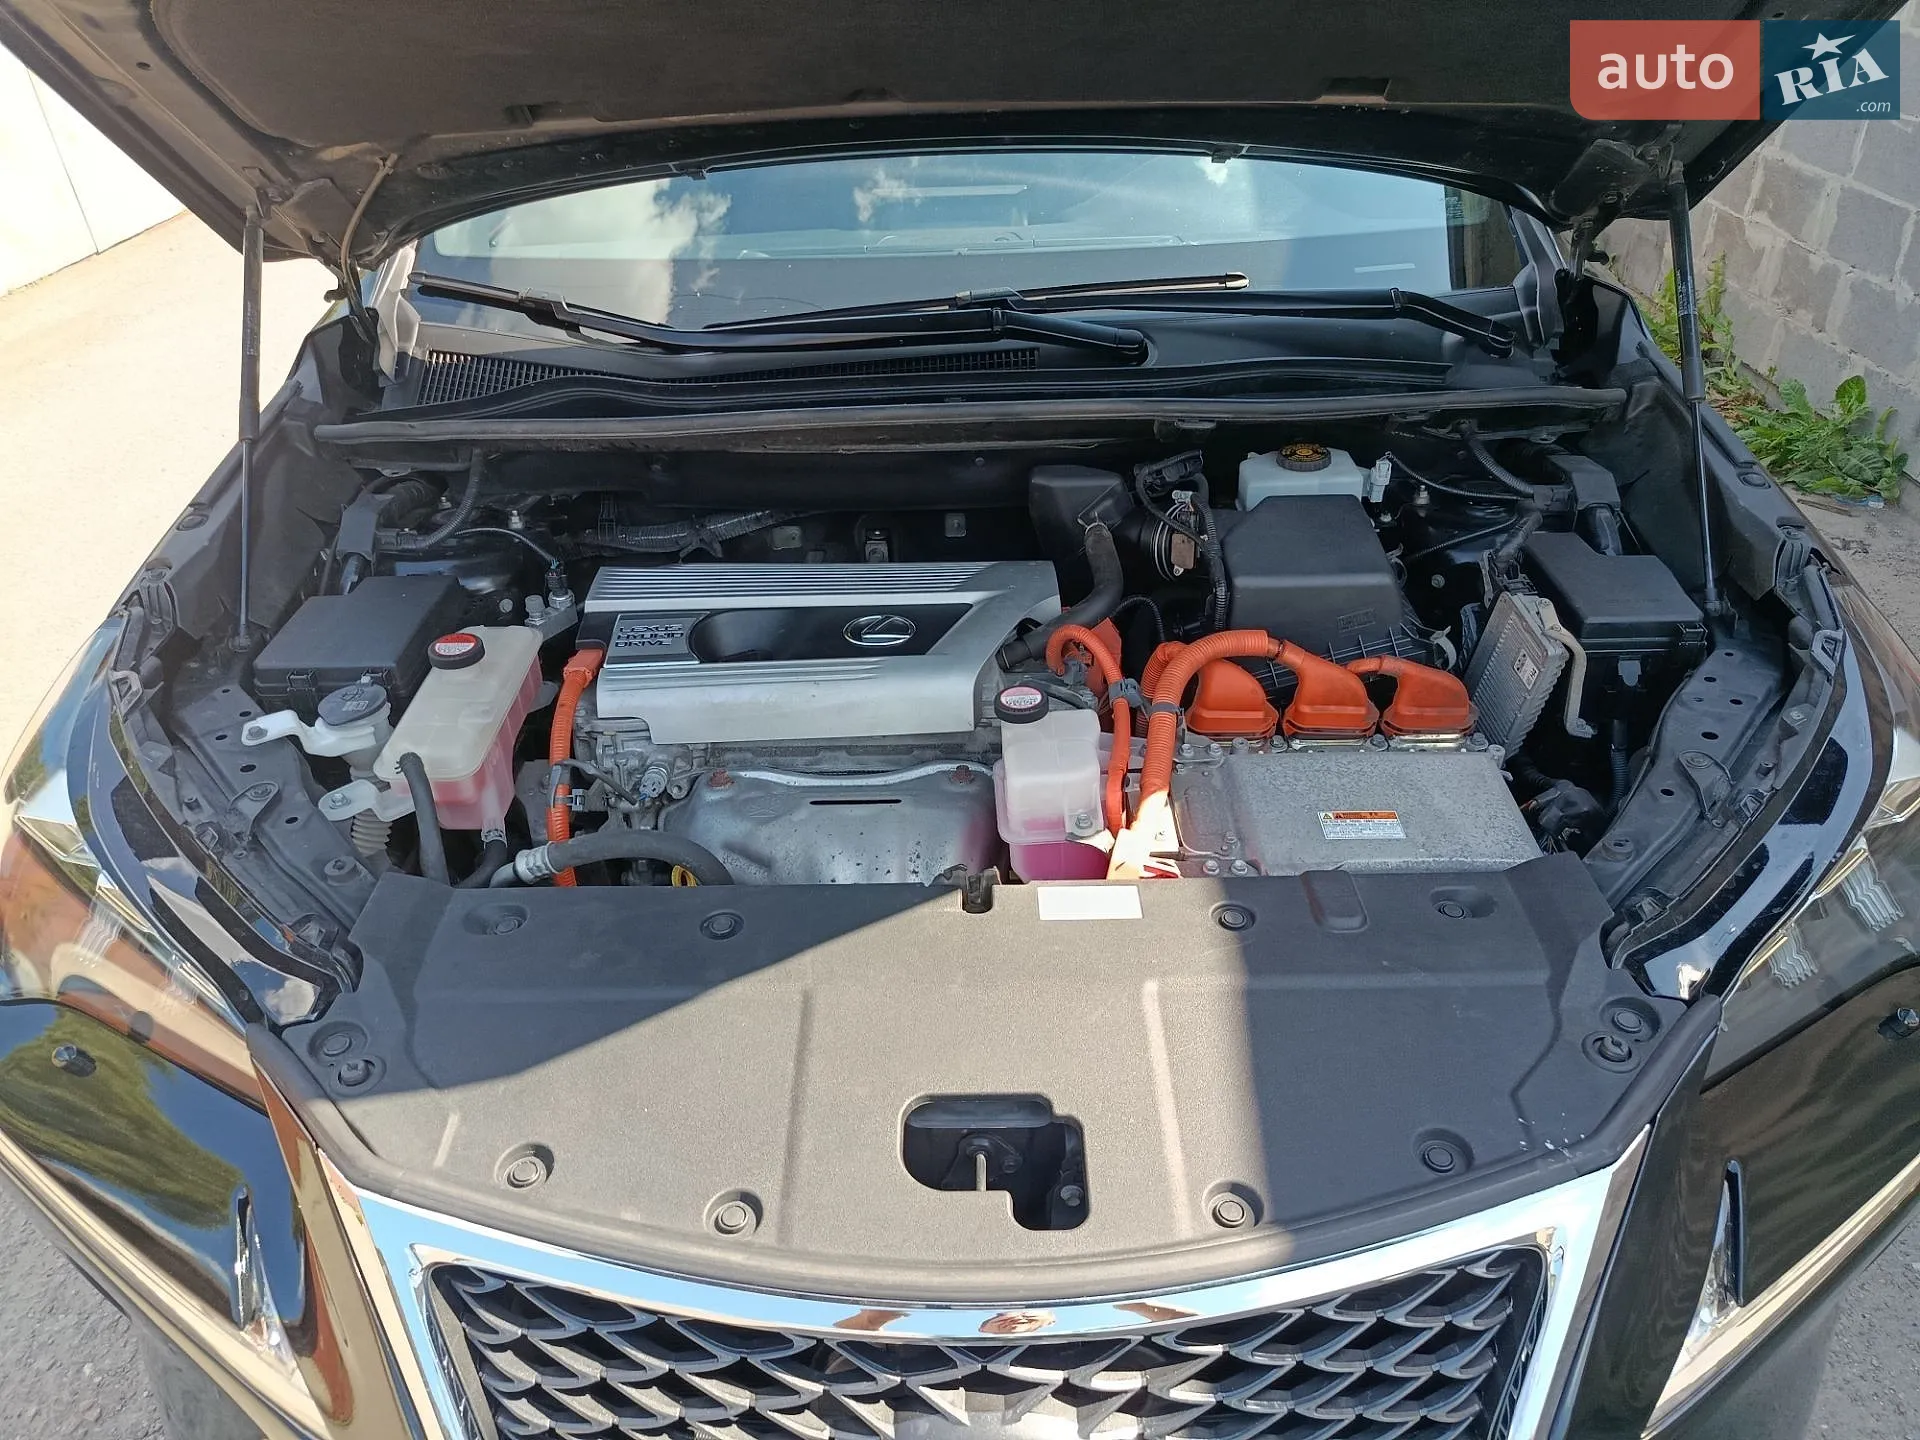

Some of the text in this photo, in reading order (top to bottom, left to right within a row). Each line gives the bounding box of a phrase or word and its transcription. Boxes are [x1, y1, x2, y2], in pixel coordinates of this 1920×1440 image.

[619, 624, 683, 632] LEXUS
[617, 631, 684, 640] HYBRID
[615, 639, 671, 647] DRIVE
